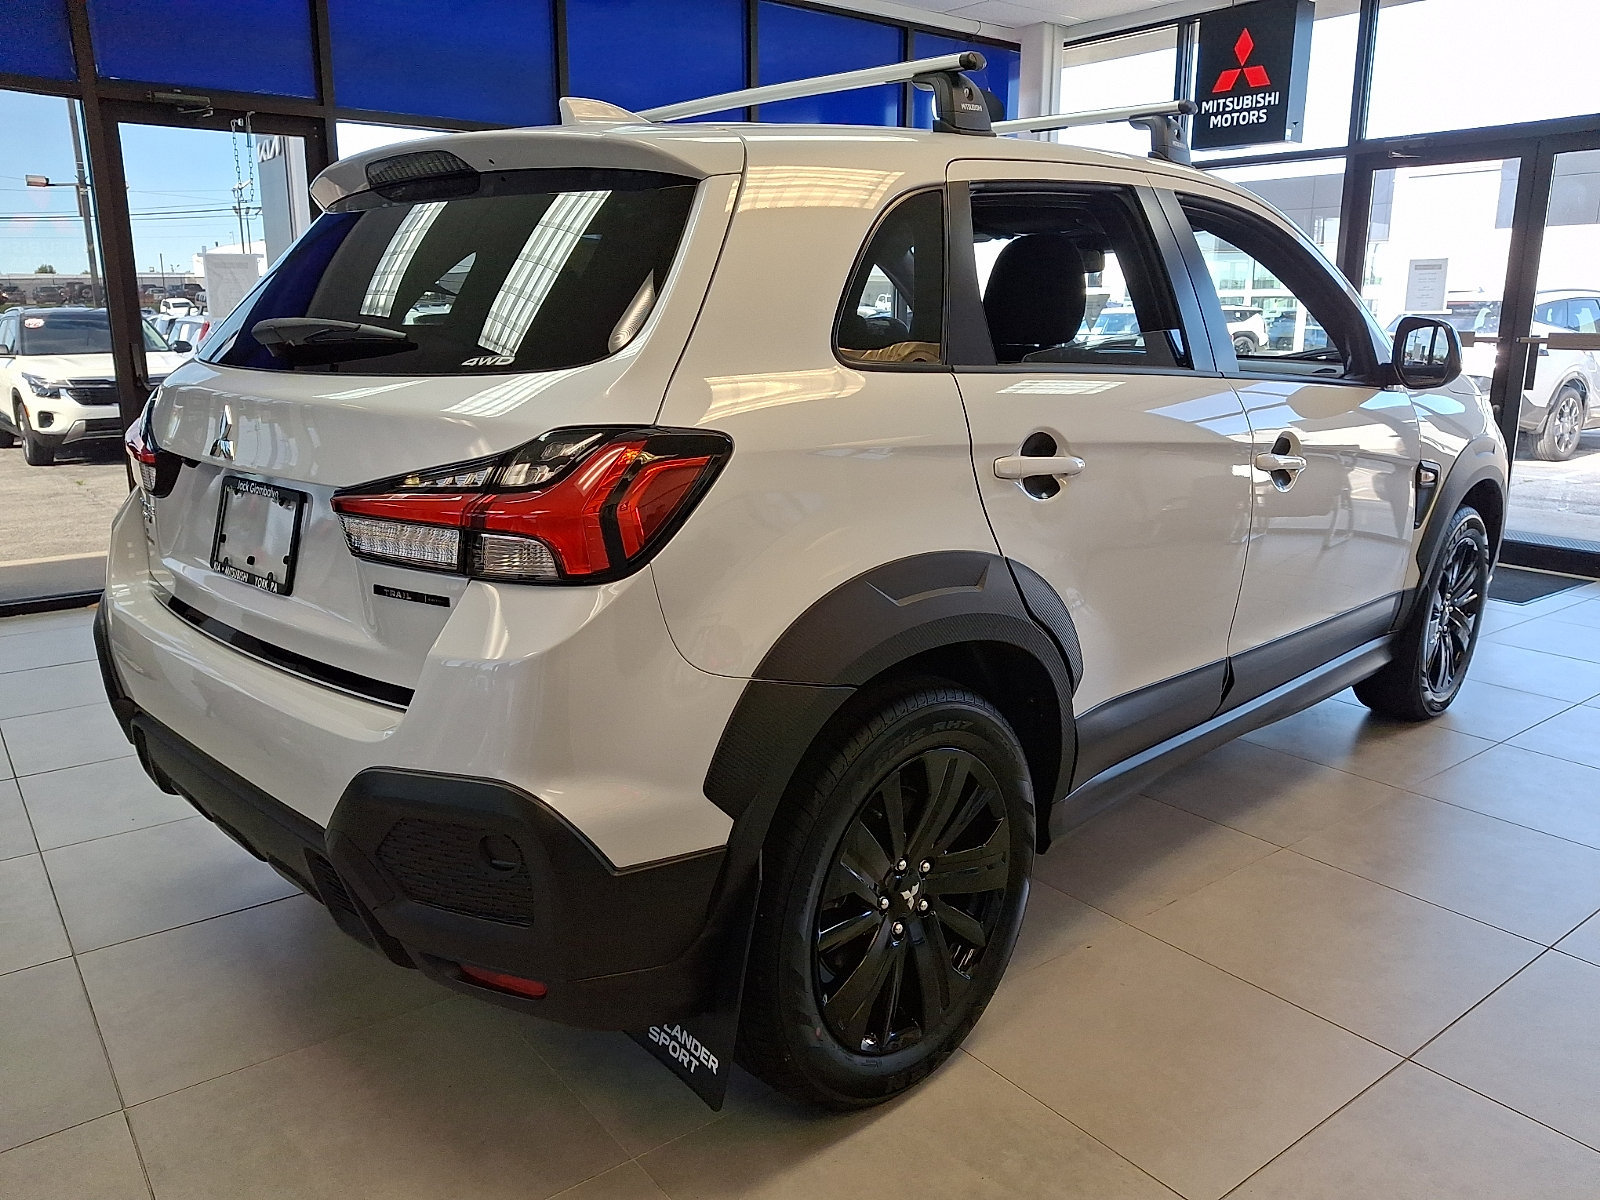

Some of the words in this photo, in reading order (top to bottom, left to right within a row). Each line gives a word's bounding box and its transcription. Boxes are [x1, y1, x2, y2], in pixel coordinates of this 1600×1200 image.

[1201, 91, 1280, 115] MITSUBISHI
[1209, 108, 1268, 129] MOTORS
[461, 356, 516, 367] 4WD
[270, 581, 278, 594] PA
[383, 588, 412, 600] TRAIL
[648, 1025, 700, 1074] SPORT
